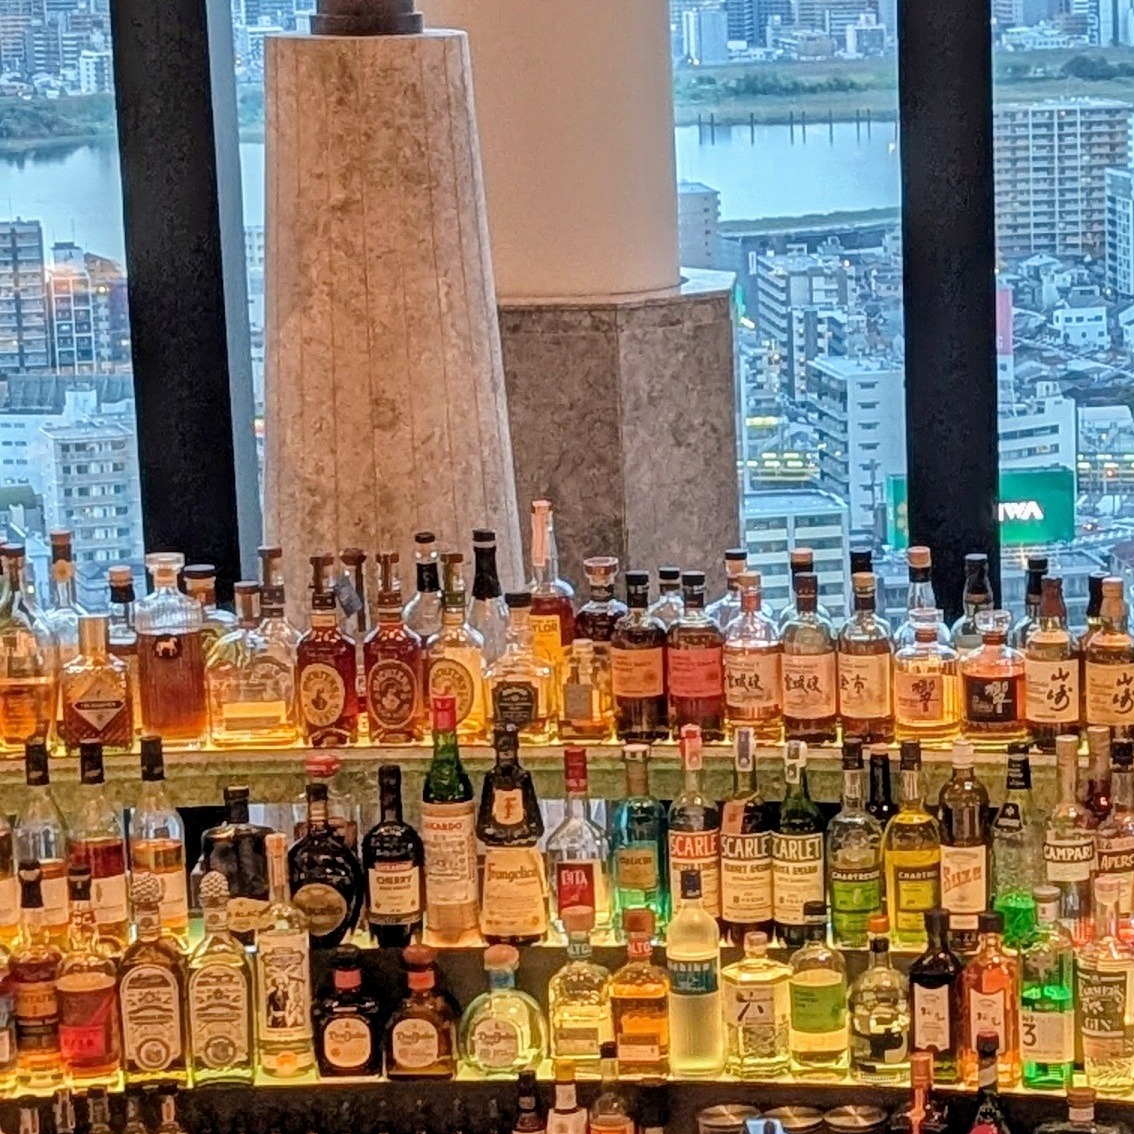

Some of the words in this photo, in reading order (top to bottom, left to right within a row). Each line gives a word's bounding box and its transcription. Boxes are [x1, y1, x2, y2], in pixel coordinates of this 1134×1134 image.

[1047, 667, 1073, 712] 山崎
[1043, 845, 1093, 861] CAMPARI
[1022, 1023, 1037, 1047] 3
